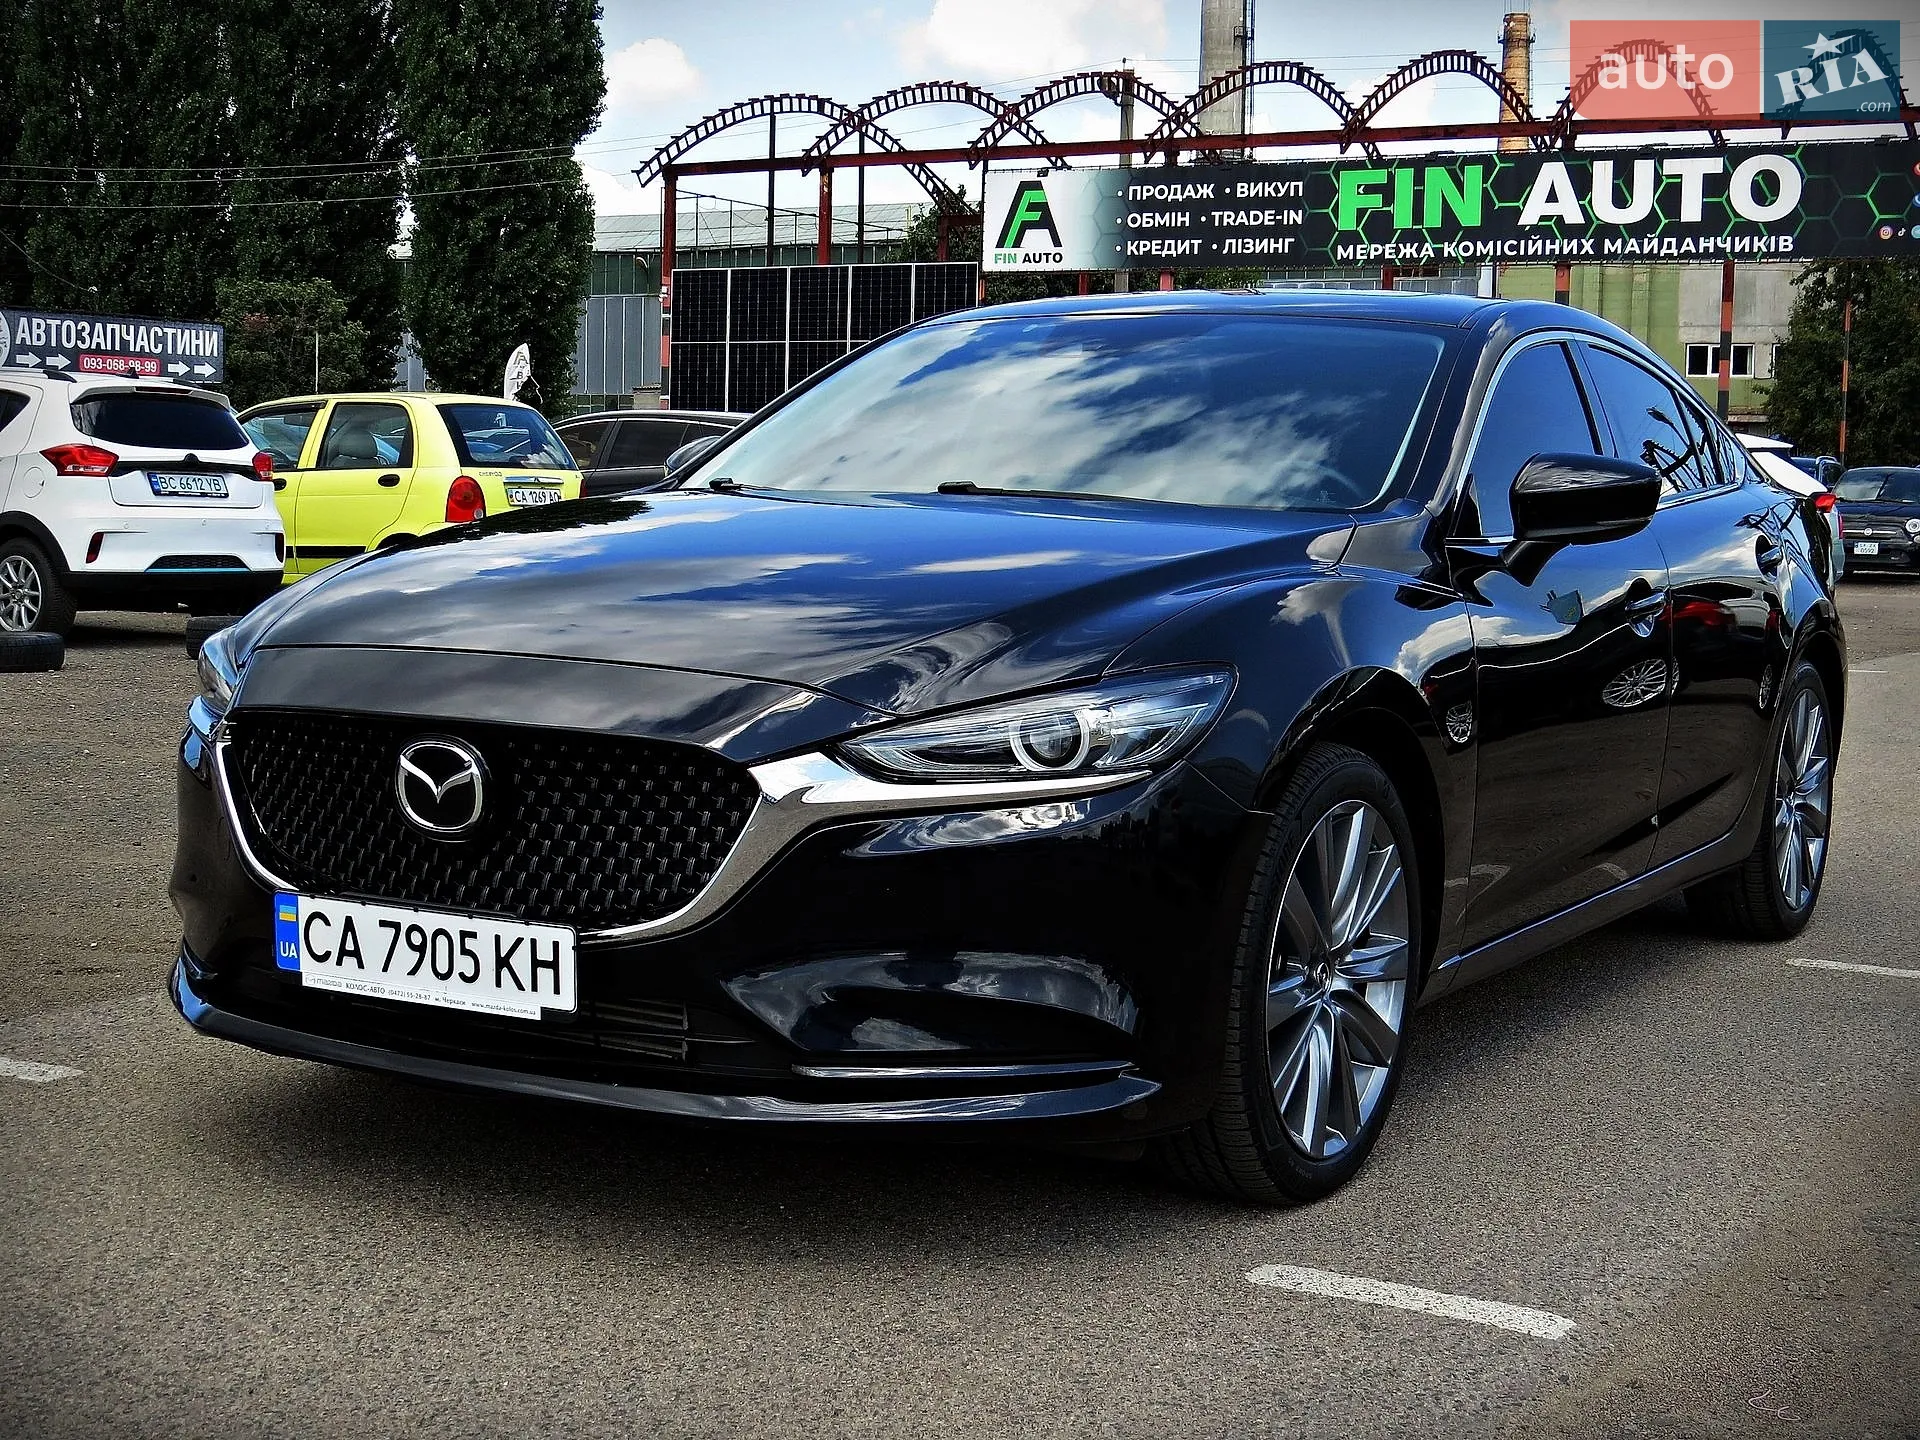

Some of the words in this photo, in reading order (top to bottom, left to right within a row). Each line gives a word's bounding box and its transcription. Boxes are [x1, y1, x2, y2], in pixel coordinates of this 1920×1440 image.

[1128, 183, 1215, 202] ПРОДАЖ
[1236, 181, 1303, 199] ВИКУП
[1338, 165, 1483, 231] FIN
[1518, 153, 1802, 227] AUTO
[1127, 212, 1190, 229] ОБМІН
[1212, 209, 1303, 227] TRADE-IN
[1127, 239, 1201, 257] КРЕДИТ
[1222, 238, 1295, 255] ЛІЗИНГ
[1337, 242, 1436, 260] МЕРЕЖА
[1443, 234, 1595, 258] КОМІСІЙНИХ
[1604, 234, 1794, 257] МАЙДАНЧИКІВ
[994, 253, 1017, 265] FIN
[1022, 253, 1063, 265] AUTO
[15, 317, 219, 357] АВТОЗАПЧАСТИНИ
[84, 357, 157, 373] 093-068-98-99
[159, 476, 177, 490] BC
[180, 477, 205, 490] 6612
[205, 478, 221, 491] YB
[515, 491, 527, 503] CA
[529, 491, 546, 504] 1269
[280, 941, 298, 959] UA
[303, 911, 365, 970] CA
[378, 919, 480, 984] 7905
[494, 933, 561, 995] KH
